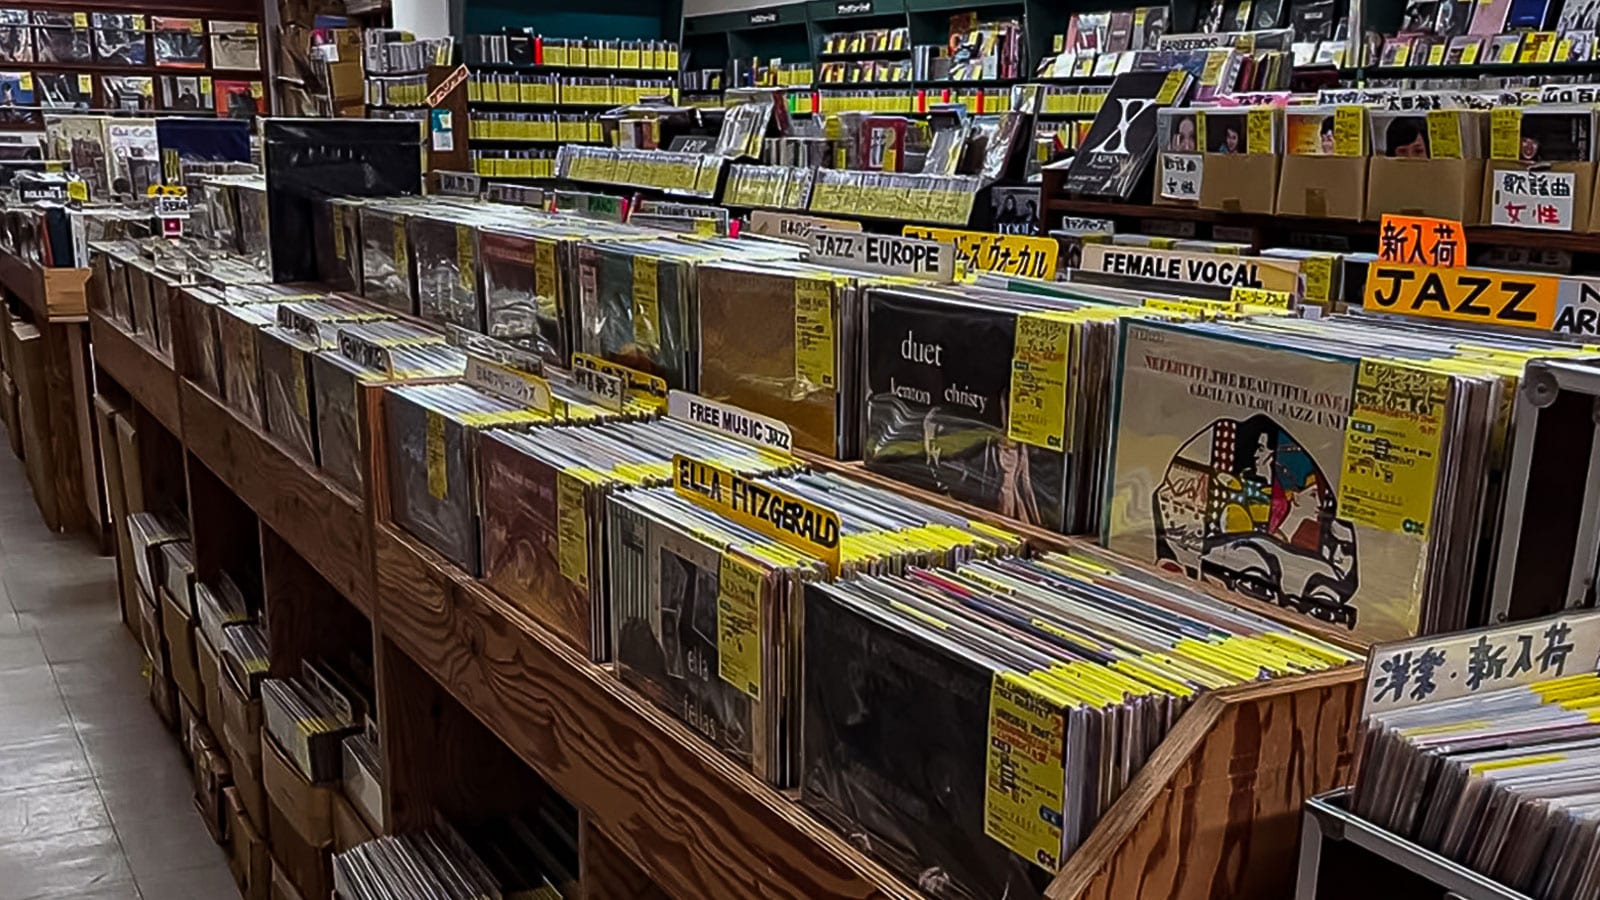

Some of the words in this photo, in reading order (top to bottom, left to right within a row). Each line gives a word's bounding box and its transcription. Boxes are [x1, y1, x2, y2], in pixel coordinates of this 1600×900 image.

[1503, 173, 1571, 197] 歌謡曲
[1504, 201, 1560, 225] 女性
[815, 234, 856, 258] JAZZ
[866, 237, 940, 273] EUROPE
[1381, 220, 1457, 269] 新入荷
[1102, 252, 1182, 280] FEMALE
[1187, 259, 1264, 290] VOCAL
[1374, 267, 1538, 322] JAZZ
[901, 330, 943, 367] duet
[689, 401, 720, 427] FREE
[722, 410, 763, 442] MUSIC
[764, 424, 790, 450] JAZZ
[679, 459, 723, 504] ELLA
[730, 476, 840, 550] FITZGERALD
